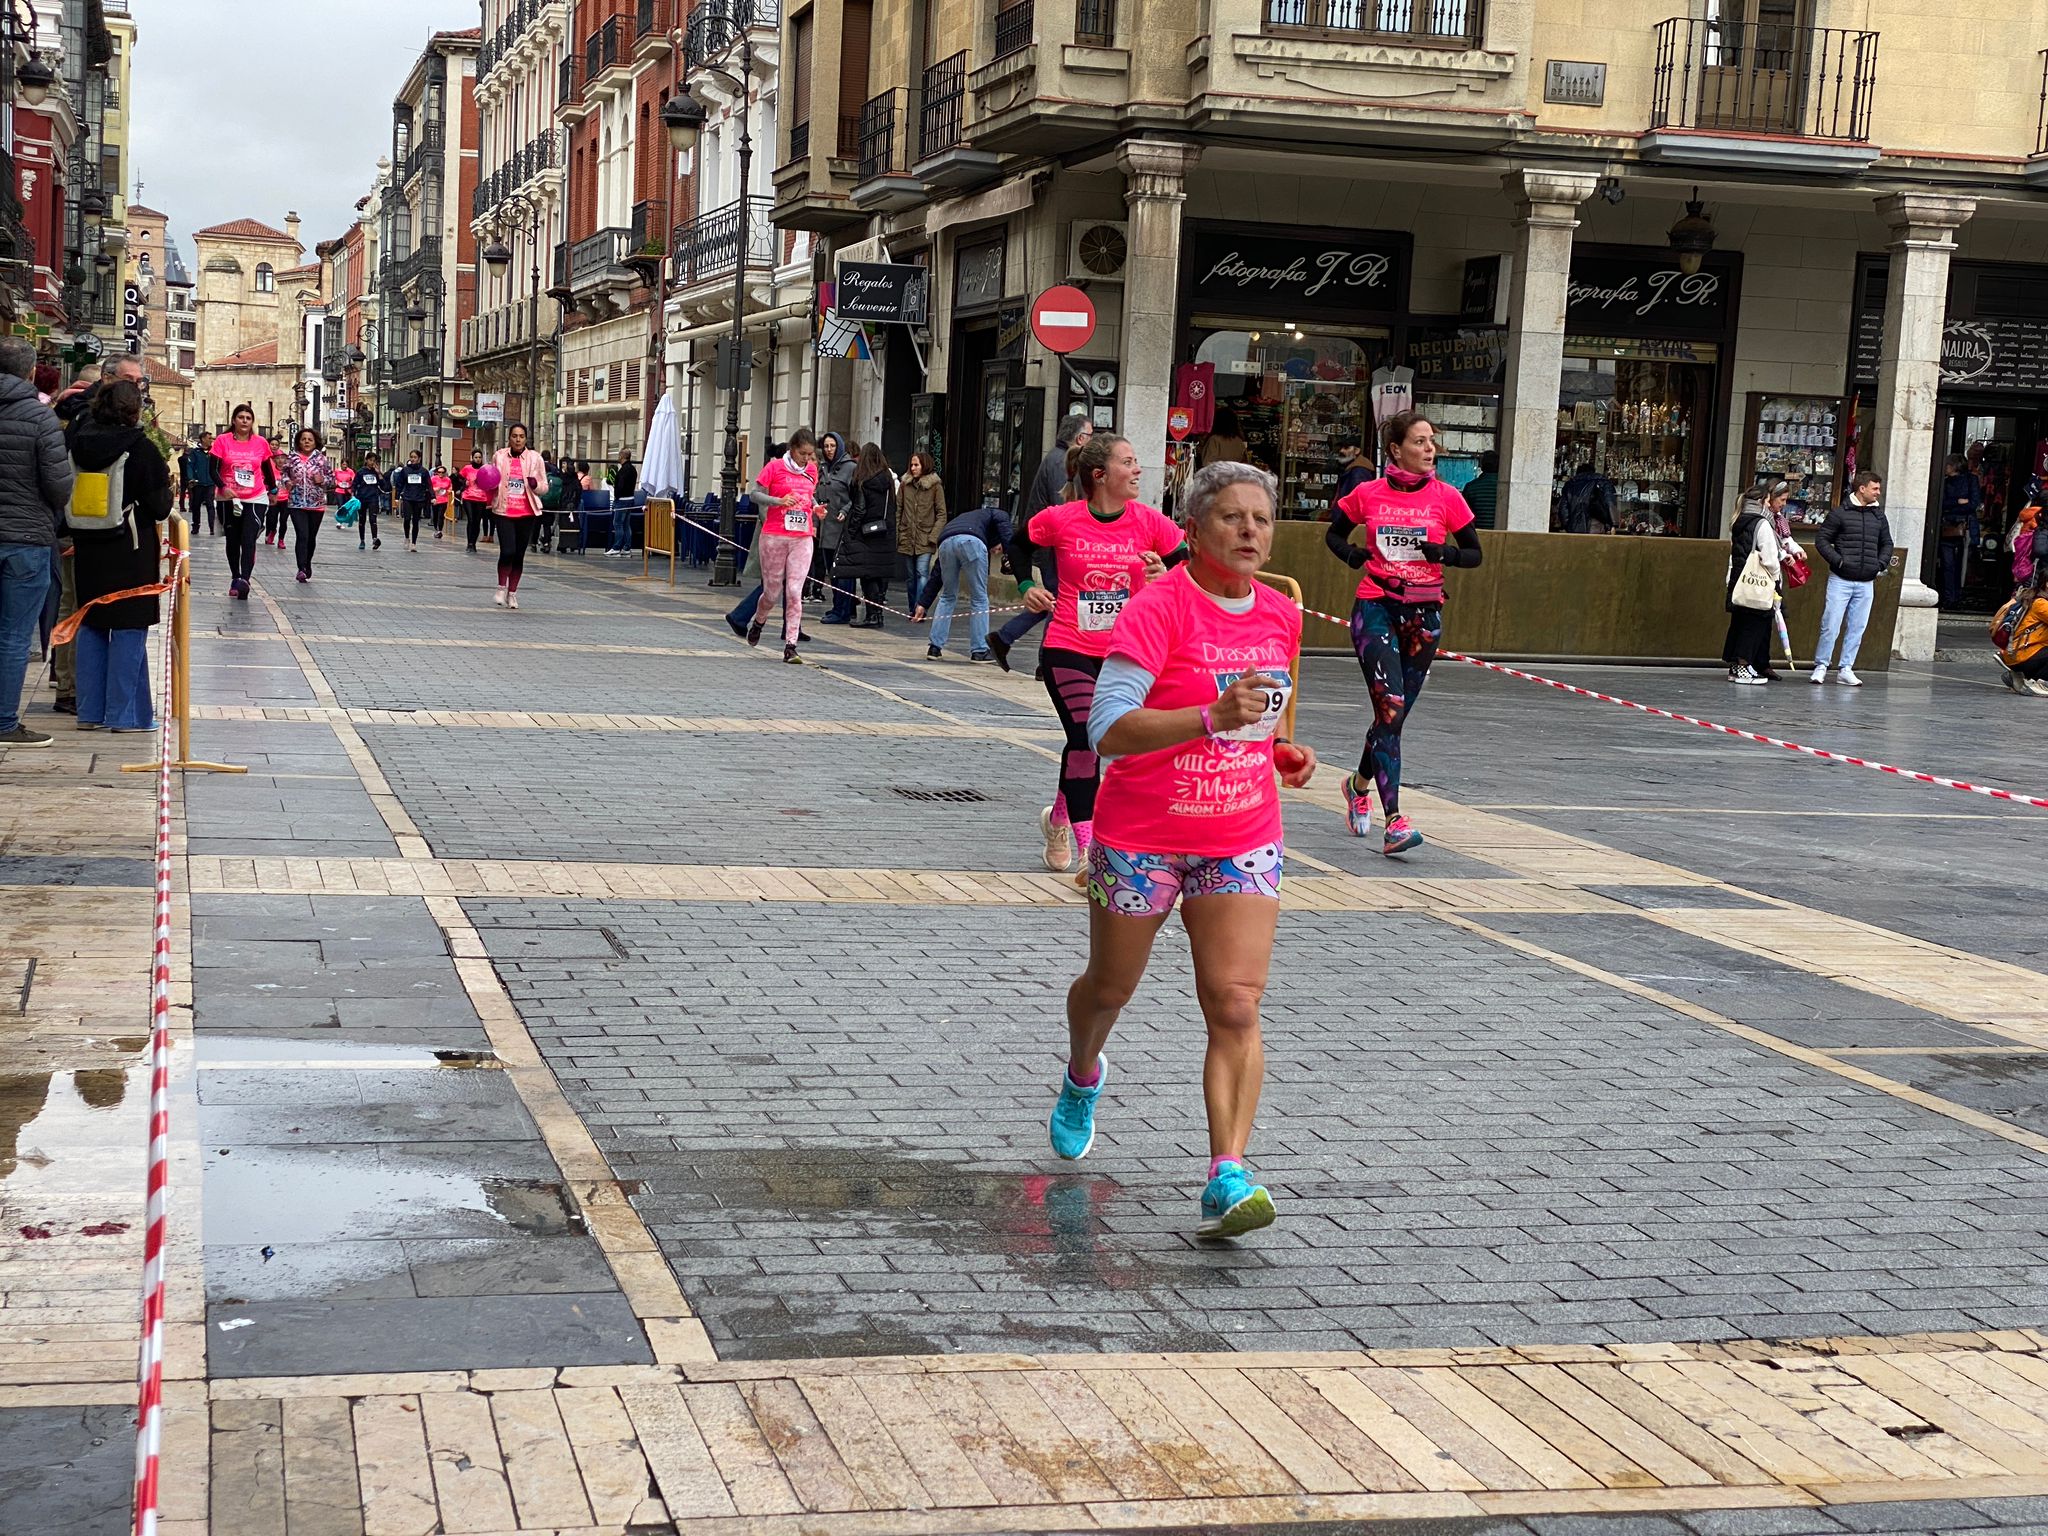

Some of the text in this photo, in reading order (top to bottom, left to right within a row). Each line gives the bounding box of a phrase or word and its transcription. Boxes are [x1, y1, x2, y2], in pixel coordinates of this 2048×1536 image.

[1560, 76, 1591, 85] PLAZA
[1551, 88, 1597, 98] DE REGLA
[842, 270, 894, 292] Regalos
[842, 295, 898, 313] Souvenir
[1421, 358, 1443, 375] DE
[1379, 384, 1407, 396] LEON
[1379, 503, 1432, 517] Drasanvi
[789, 516, 807, 524] 2127
[1075, 537, 1135, 553] Drasanvi
[1385, 535, 1418, 547] 1394
[1088, 602, 1123, 614] 1393
[1202, 638, 1281, 662] Drasanvi
[1173, 752, 1267, 773] VIII CARRERA
[1192, 776, 1254, 804] Mujer
